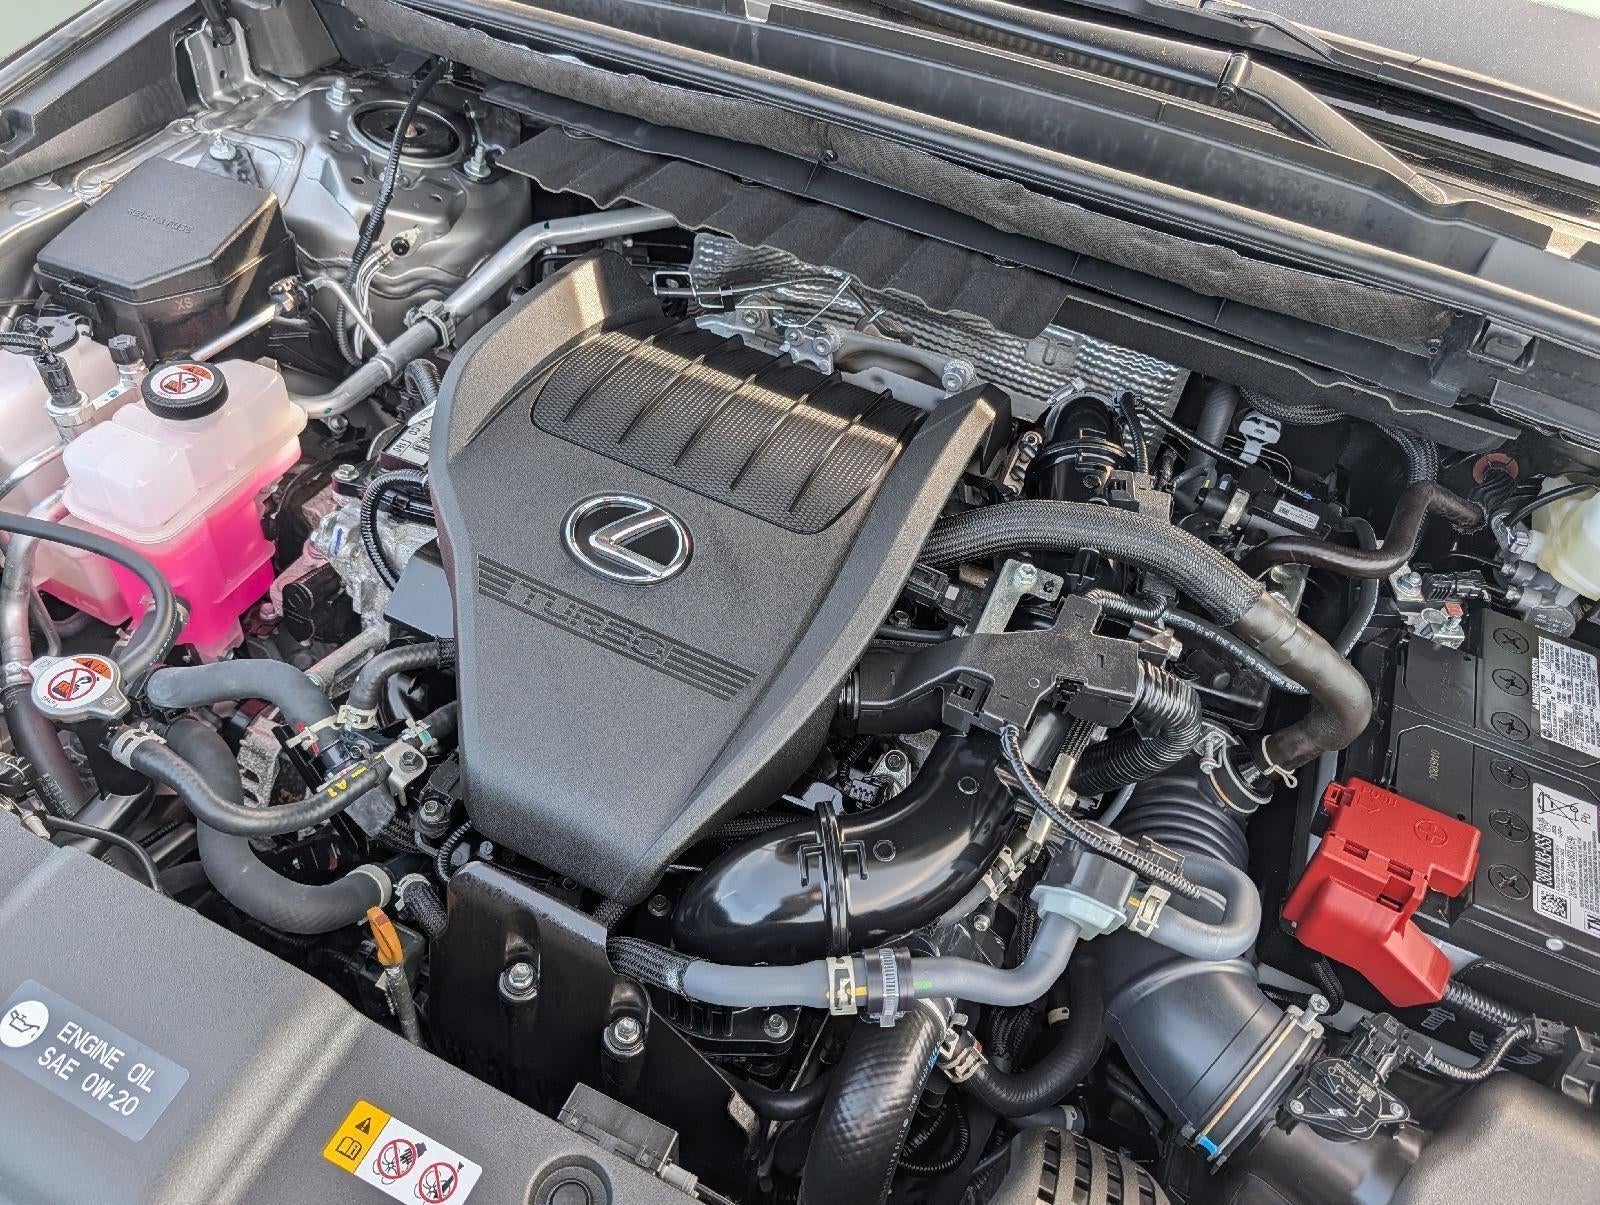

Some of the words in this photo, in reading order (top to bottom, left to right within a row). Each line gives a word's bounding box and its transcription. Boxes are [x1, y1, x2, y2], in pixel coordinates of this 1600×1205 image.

[517, 578, 667, 662] TURBO
[37, 1046, 81, 1081] SAE
[81, 1072, 140, 1116] 0W-20
[56, 1021, 126, 1071] ENGINE
[127, 1063, 155, 1093] OIL
